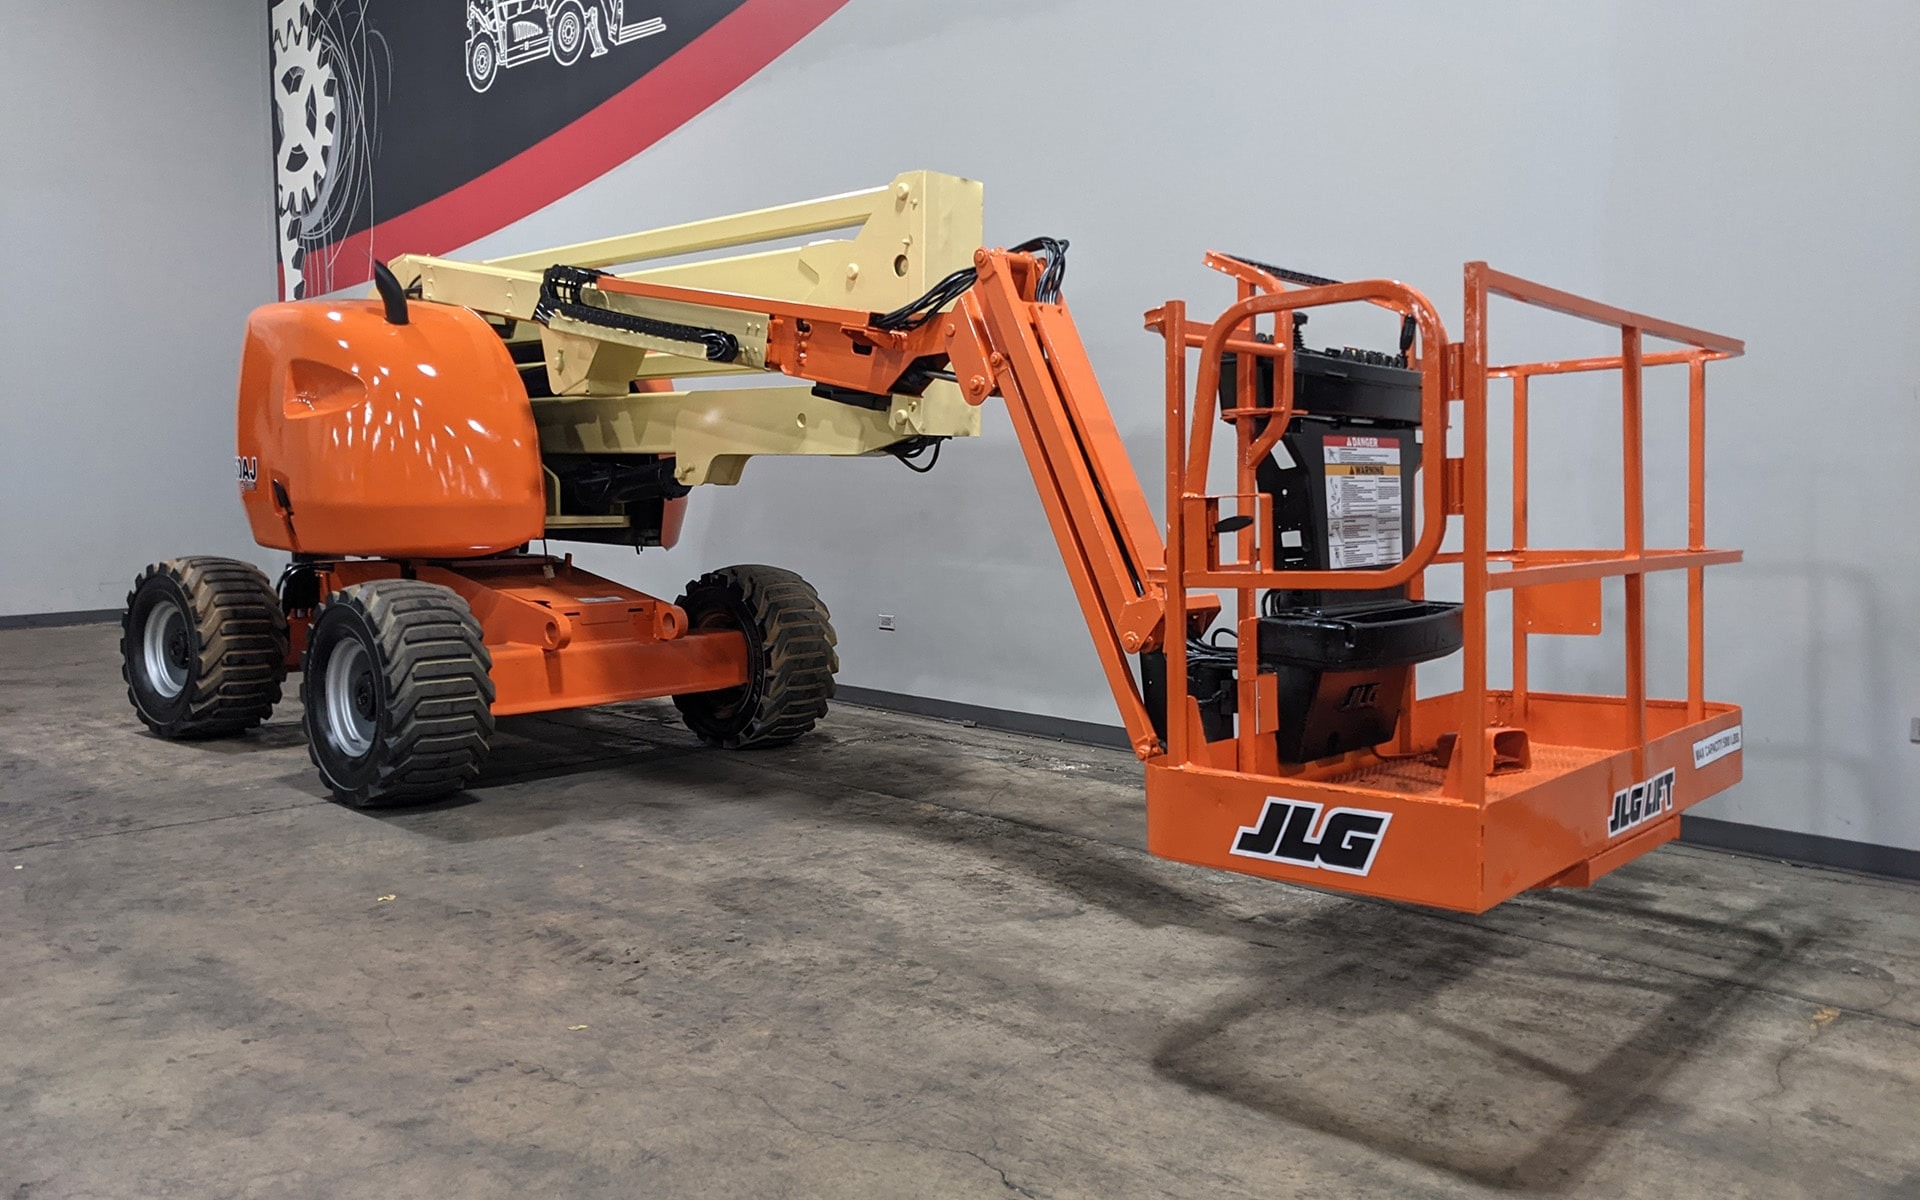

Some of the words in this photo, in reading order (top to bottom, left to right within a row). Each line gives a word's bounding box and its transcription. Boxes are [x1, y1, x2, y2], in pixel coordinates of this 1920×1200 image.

[1352, 437, 1379, 448] DANGER
[1356, 466, 1384, 475] WARNING
[1610, 785, 1645, 834] JLG
[1643, 771, 1674, 818] LIFT
[1234, 800, 1388, 873] JLG
